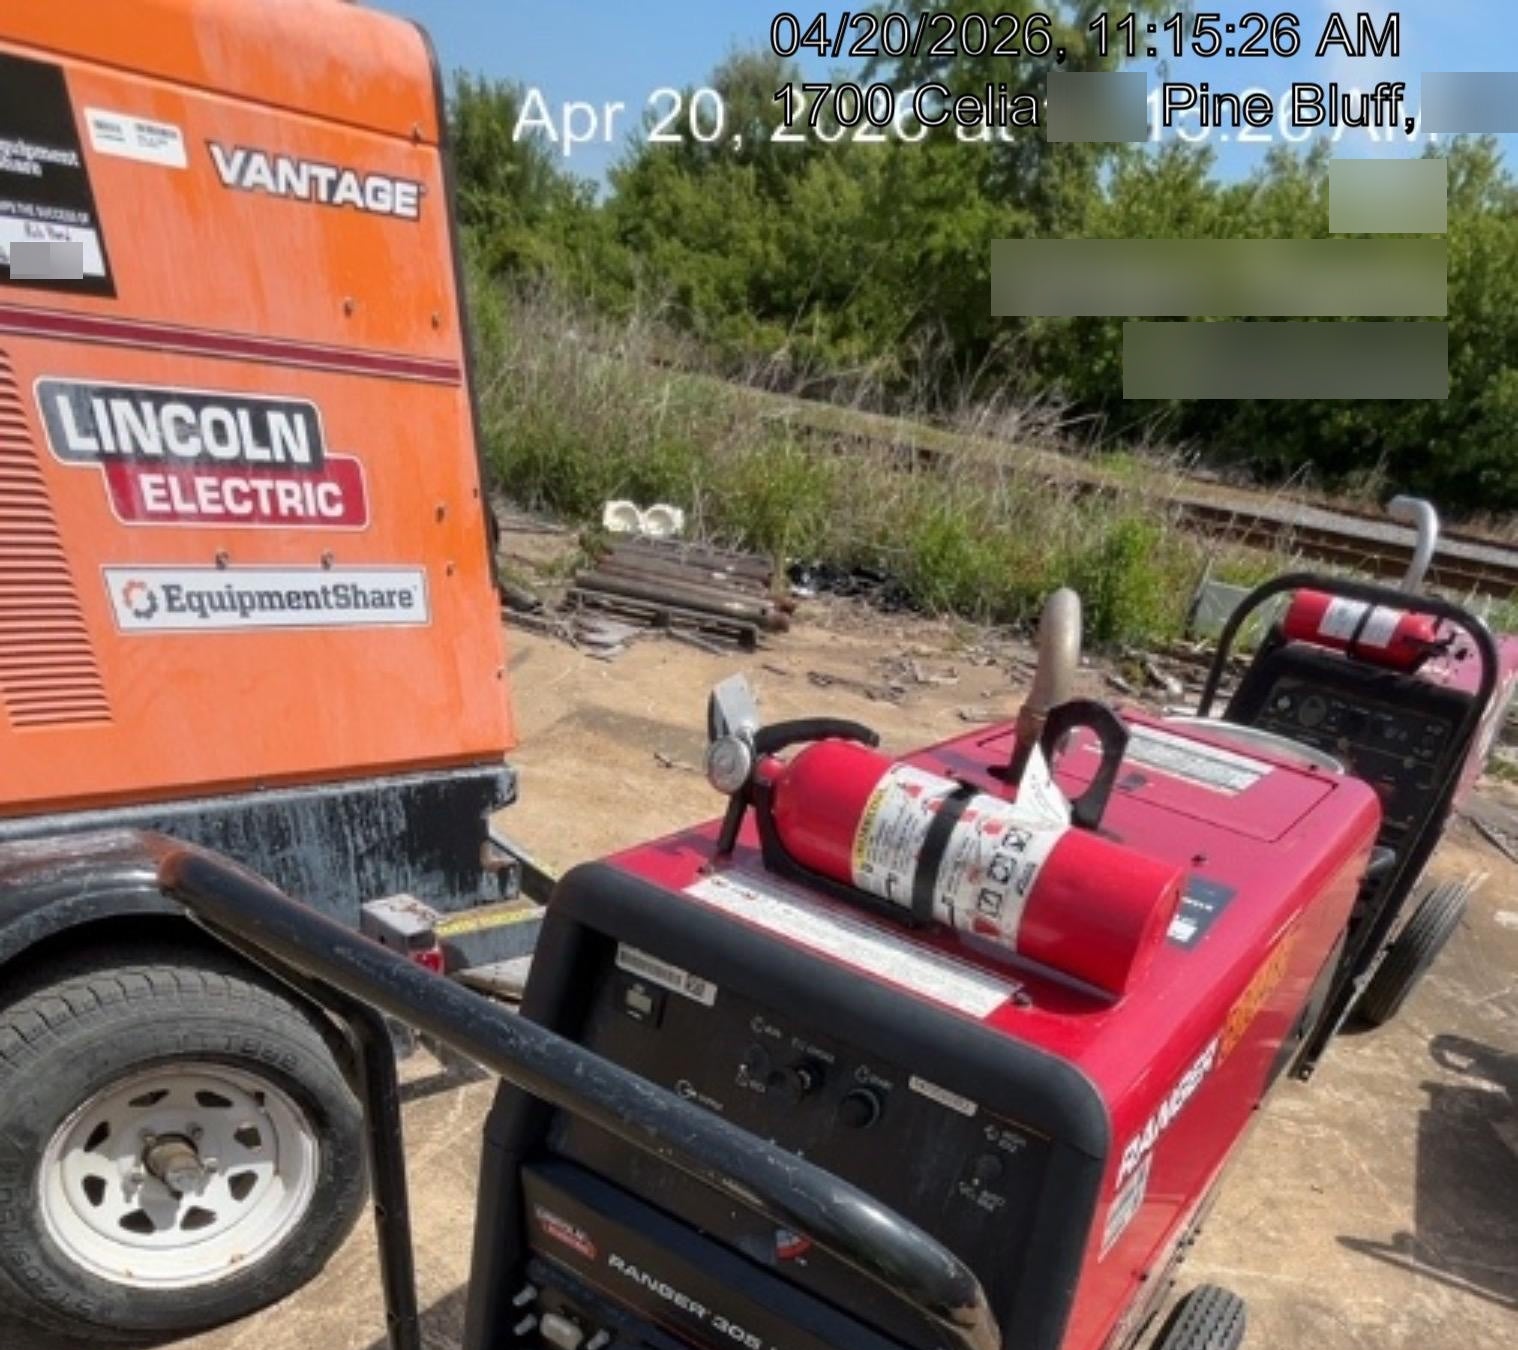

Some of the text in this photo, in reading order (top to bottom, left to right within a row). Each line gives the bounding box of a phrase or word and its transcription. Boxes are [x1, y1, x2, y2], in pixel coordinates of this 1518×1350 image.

[209, 142, 420, 218] VANTAGE
[56, 395, 311, 463] LINCOLN
[138, 473, 345, 517] ELECTRIC
[161, 582, 414, 619] EquipmentShare
[608, 1254, 706, 1318] RANGER
[711, 1316, 762, 1350] 305
